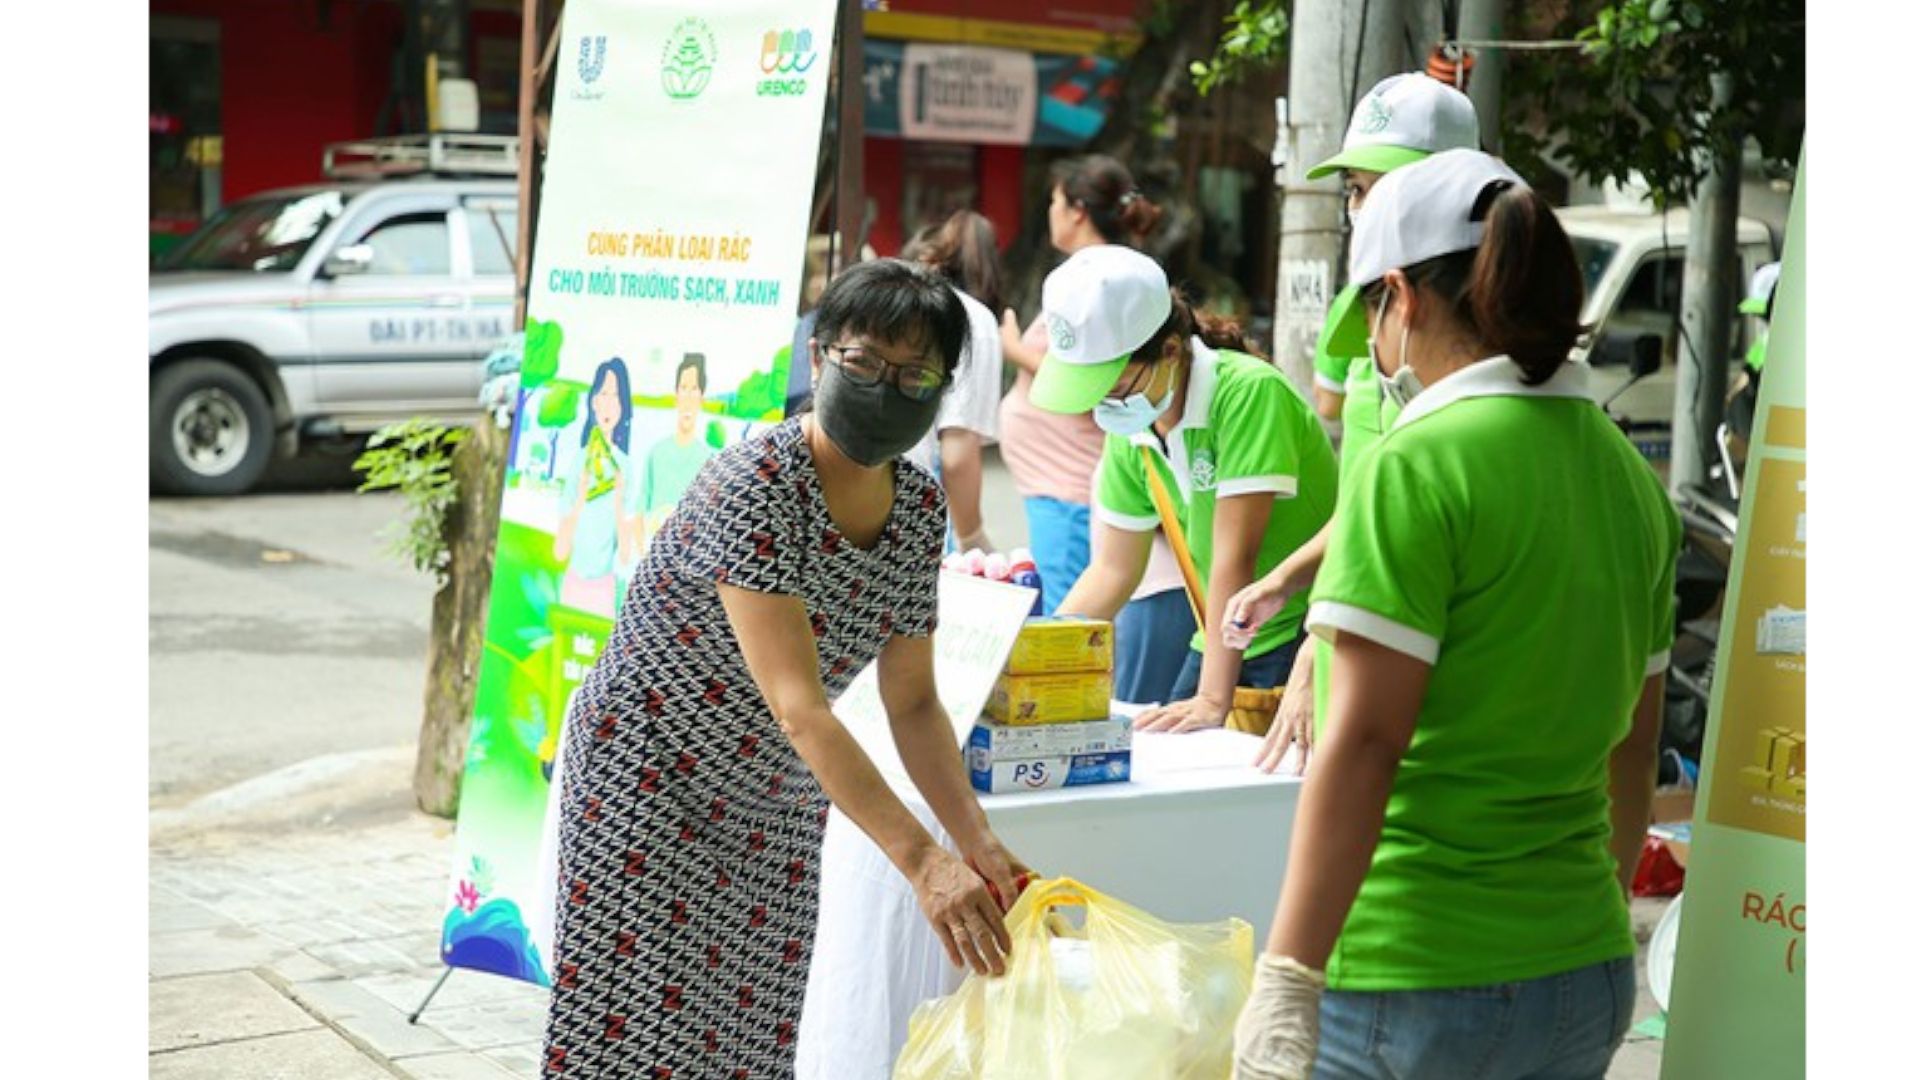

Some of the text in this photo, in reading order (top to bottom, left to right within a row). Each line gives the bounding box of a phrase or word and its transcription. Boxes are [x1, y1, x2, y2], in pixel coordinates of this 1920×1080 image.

[756, 79, 807, 97] URENCO
[587, 227, 752, 265] CÙNG PHÂN LOẠI RÁC
[548, 268, 584, 294] CHO
[588, 265, 617, 297] MÔI
[620, 267, 680, 301] TRƯỜNG
[733, 279, 781, 306] XANH
[1013, 761, 1046, 783] PS
